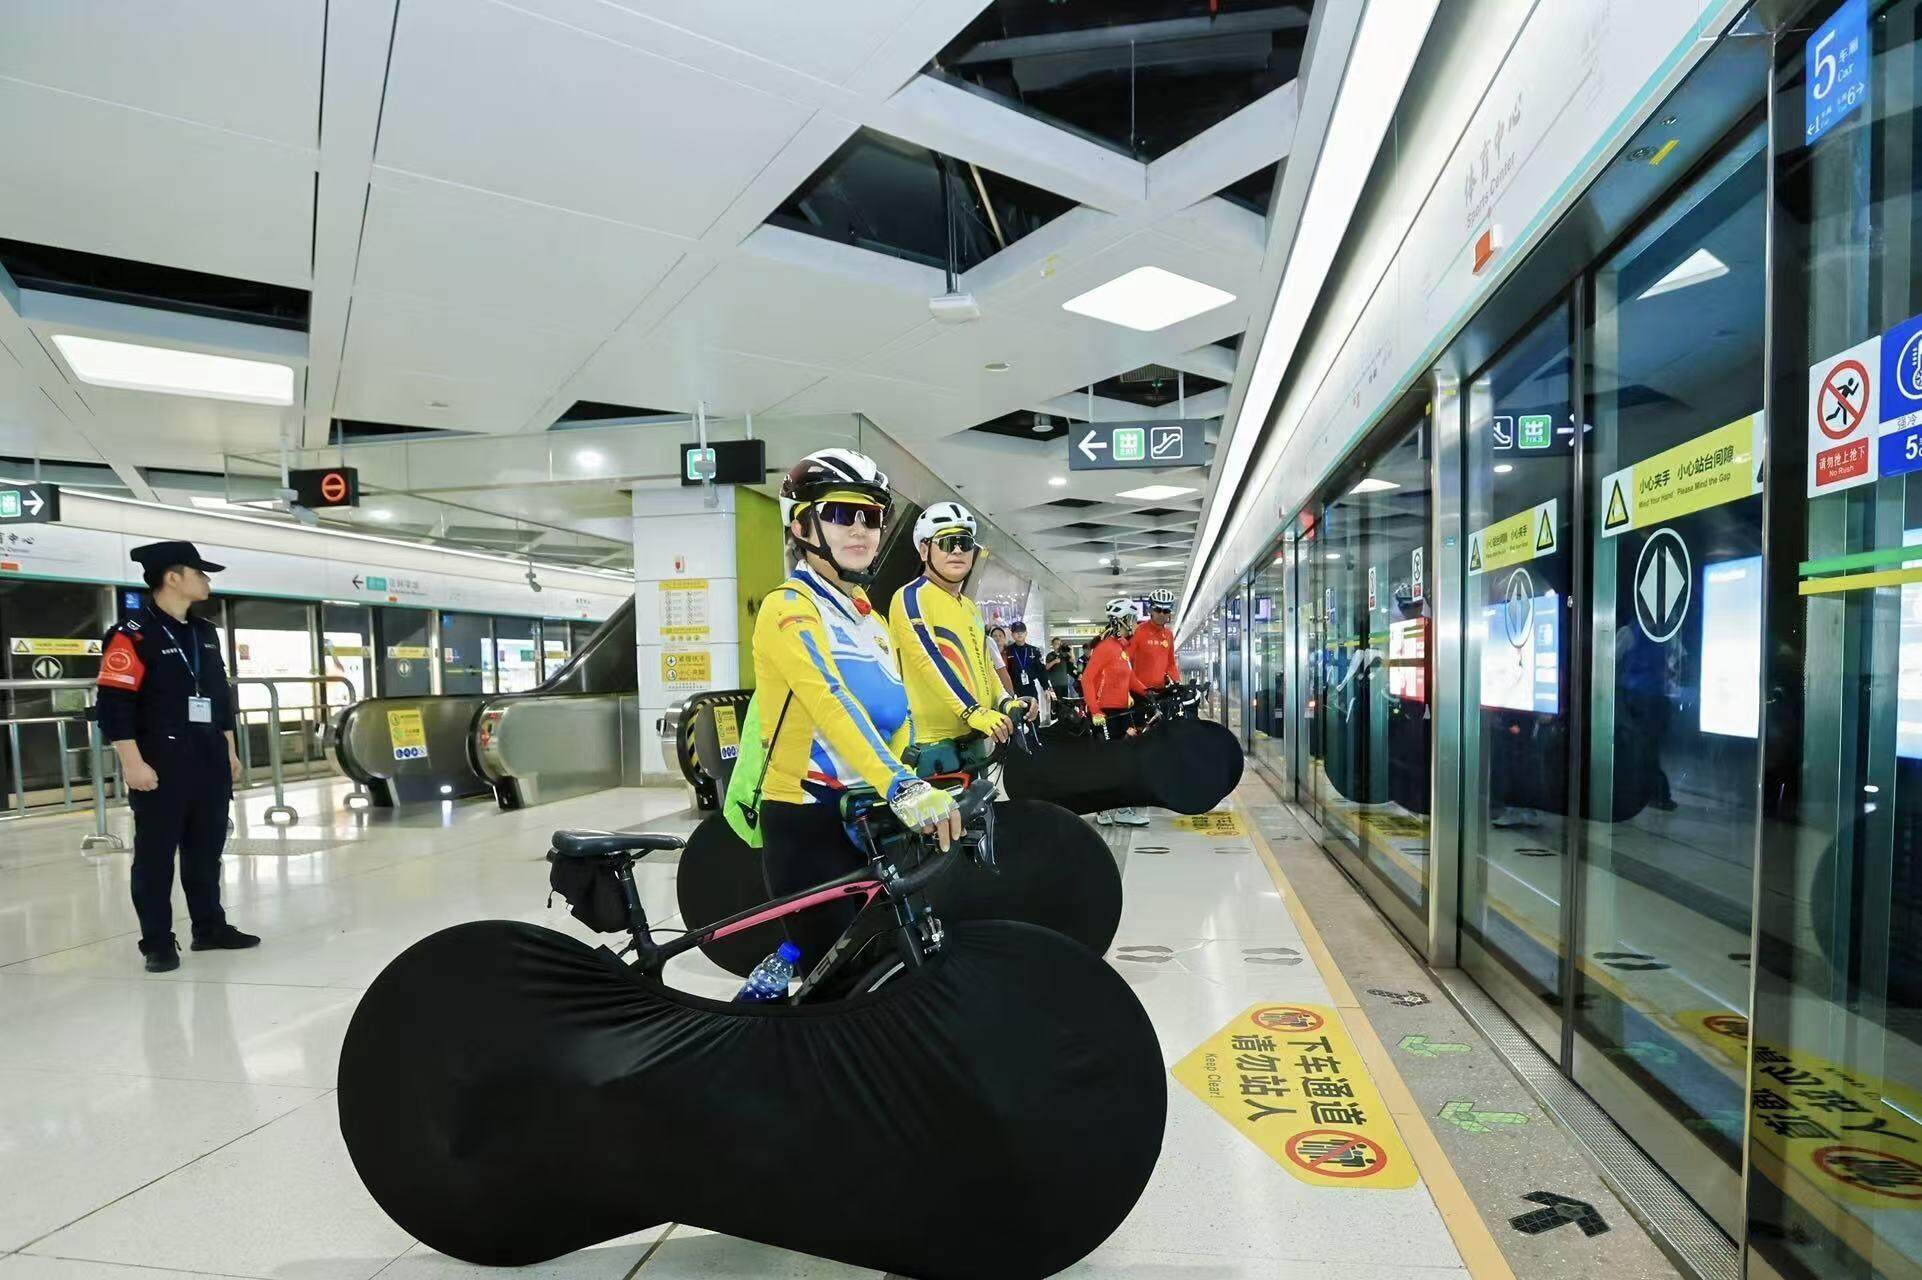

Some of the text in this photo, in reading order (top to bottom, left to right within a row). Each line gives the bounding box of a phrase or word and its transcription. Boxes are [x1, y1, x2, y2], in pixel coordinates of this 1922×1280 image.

[1813, 29, 1836, 100] 5
[1838, 63, 1855, 82] Car
[1847, 86, 1856, 105] 6
[1465, 93, 1522, 206] 体育中心
[1467, 151, 1516, 229] Sports Center
[1119, 447, 1138, 457] EXIT
[1819, 446, 1866, 470] 请勿抢上抢下
[1905, 433, 1918, 460] 5
[1640, 445, 1734, 494] 小心夹手 小心站台间隙
[1677, 485, 1694, 495] Please
[1694, 478, 1708, 490] Mind
[1708, 475, 1717, 486] the
[1718, 472, 1731, 483] Gap
[1829, 465, 1855, 477] No Rush
[1203, 1053, 1225, 1099] Keep Clear!
[1231, 1034, 1297, 1123] 请勿站人
[1287, 1036, 1368, 1125] 下车通道
